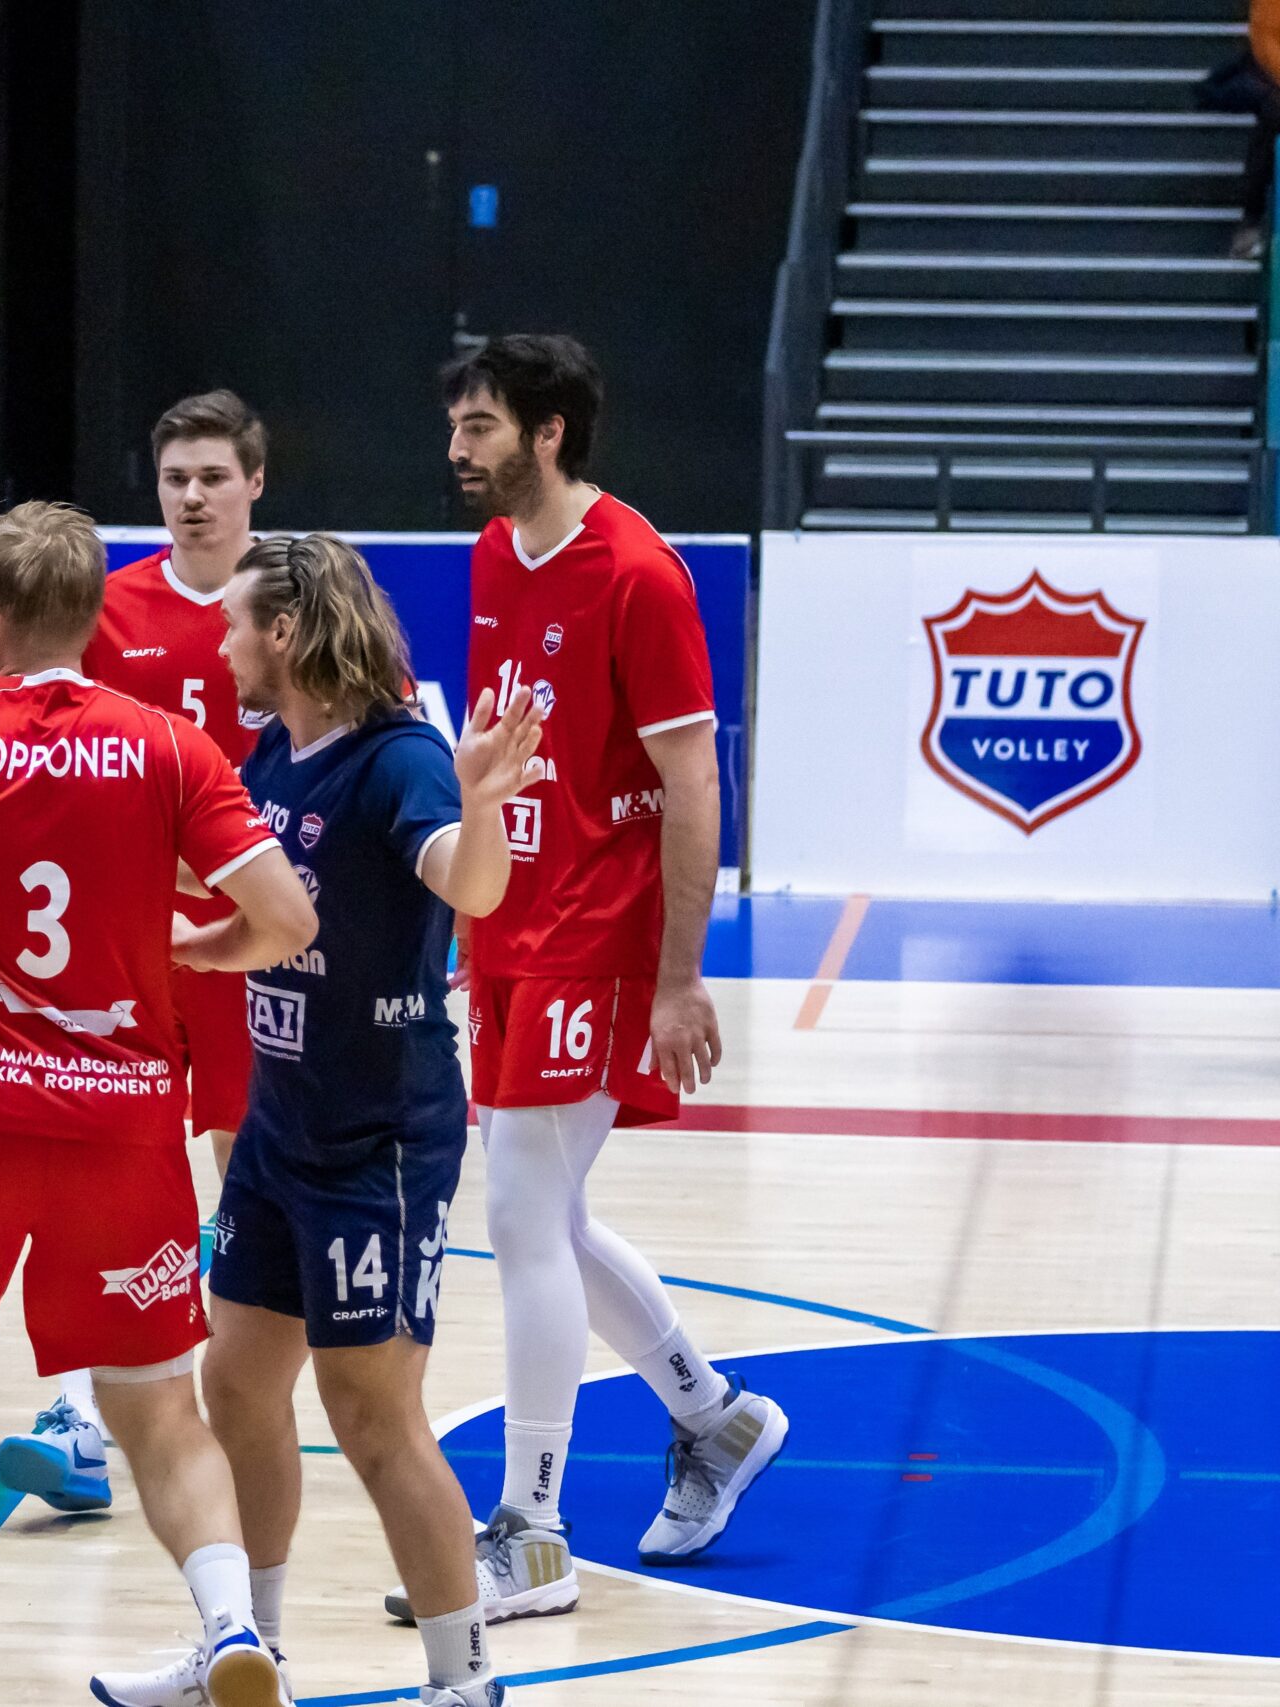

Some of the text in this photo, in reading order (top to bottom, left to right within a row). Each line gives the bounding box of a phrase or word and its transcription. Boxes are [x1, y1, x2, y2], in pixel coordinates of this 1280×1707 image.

[122, 648, 157, 659] CRAFT
[182, 678, 206, 729] 5
[951, 669, 1114, 711] TUTO
[971, 738, 1090, 762] VOLLEY
[302, 823, 320, 834] TUTO
[16, 860, 71, 980] 3
[546, 999, 593, 1060] 16
[43, 1071, 151, 1095] ROPPONEN
[157, 1077, 172, 1095] OY
[541, 1067, 584, 1079] CRAFT
[126, 1247, 184, 1302] Well
[327, 1233, 388, 1301] 14
[160, 1277, 192, 1302] Beef
[332, 1308, 376, 1321] CRAFT
[669, 1352, 692, 1382] CRAFT
[538, 1452, 554, 1491] CRAFT
[470, 1622, 480, 1658] CRAFT
